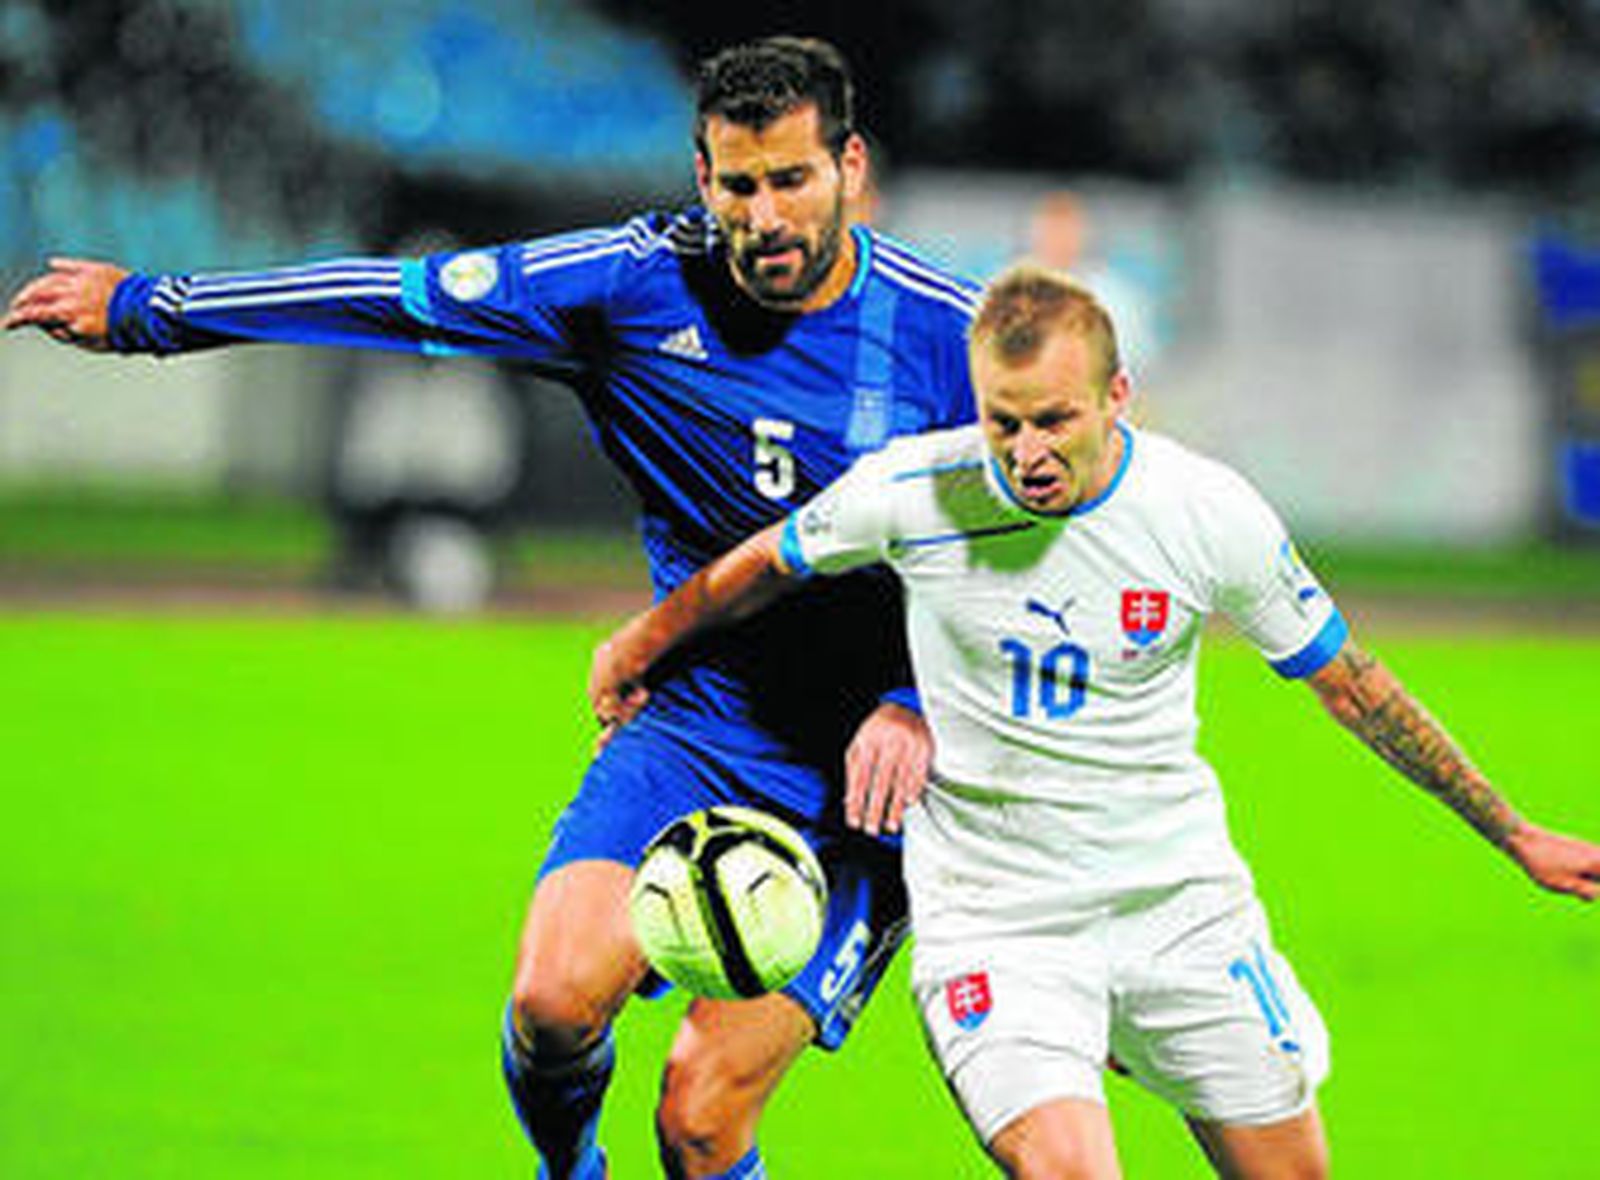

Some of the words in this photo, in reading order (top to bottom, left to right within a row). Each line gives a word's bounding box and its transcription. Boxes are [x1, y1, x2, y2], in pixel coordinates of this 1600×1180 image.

[753, 417, 795, 500] 5
[999, 637, 1089, 719] 10
[819, 919, 873, 1003] 5
